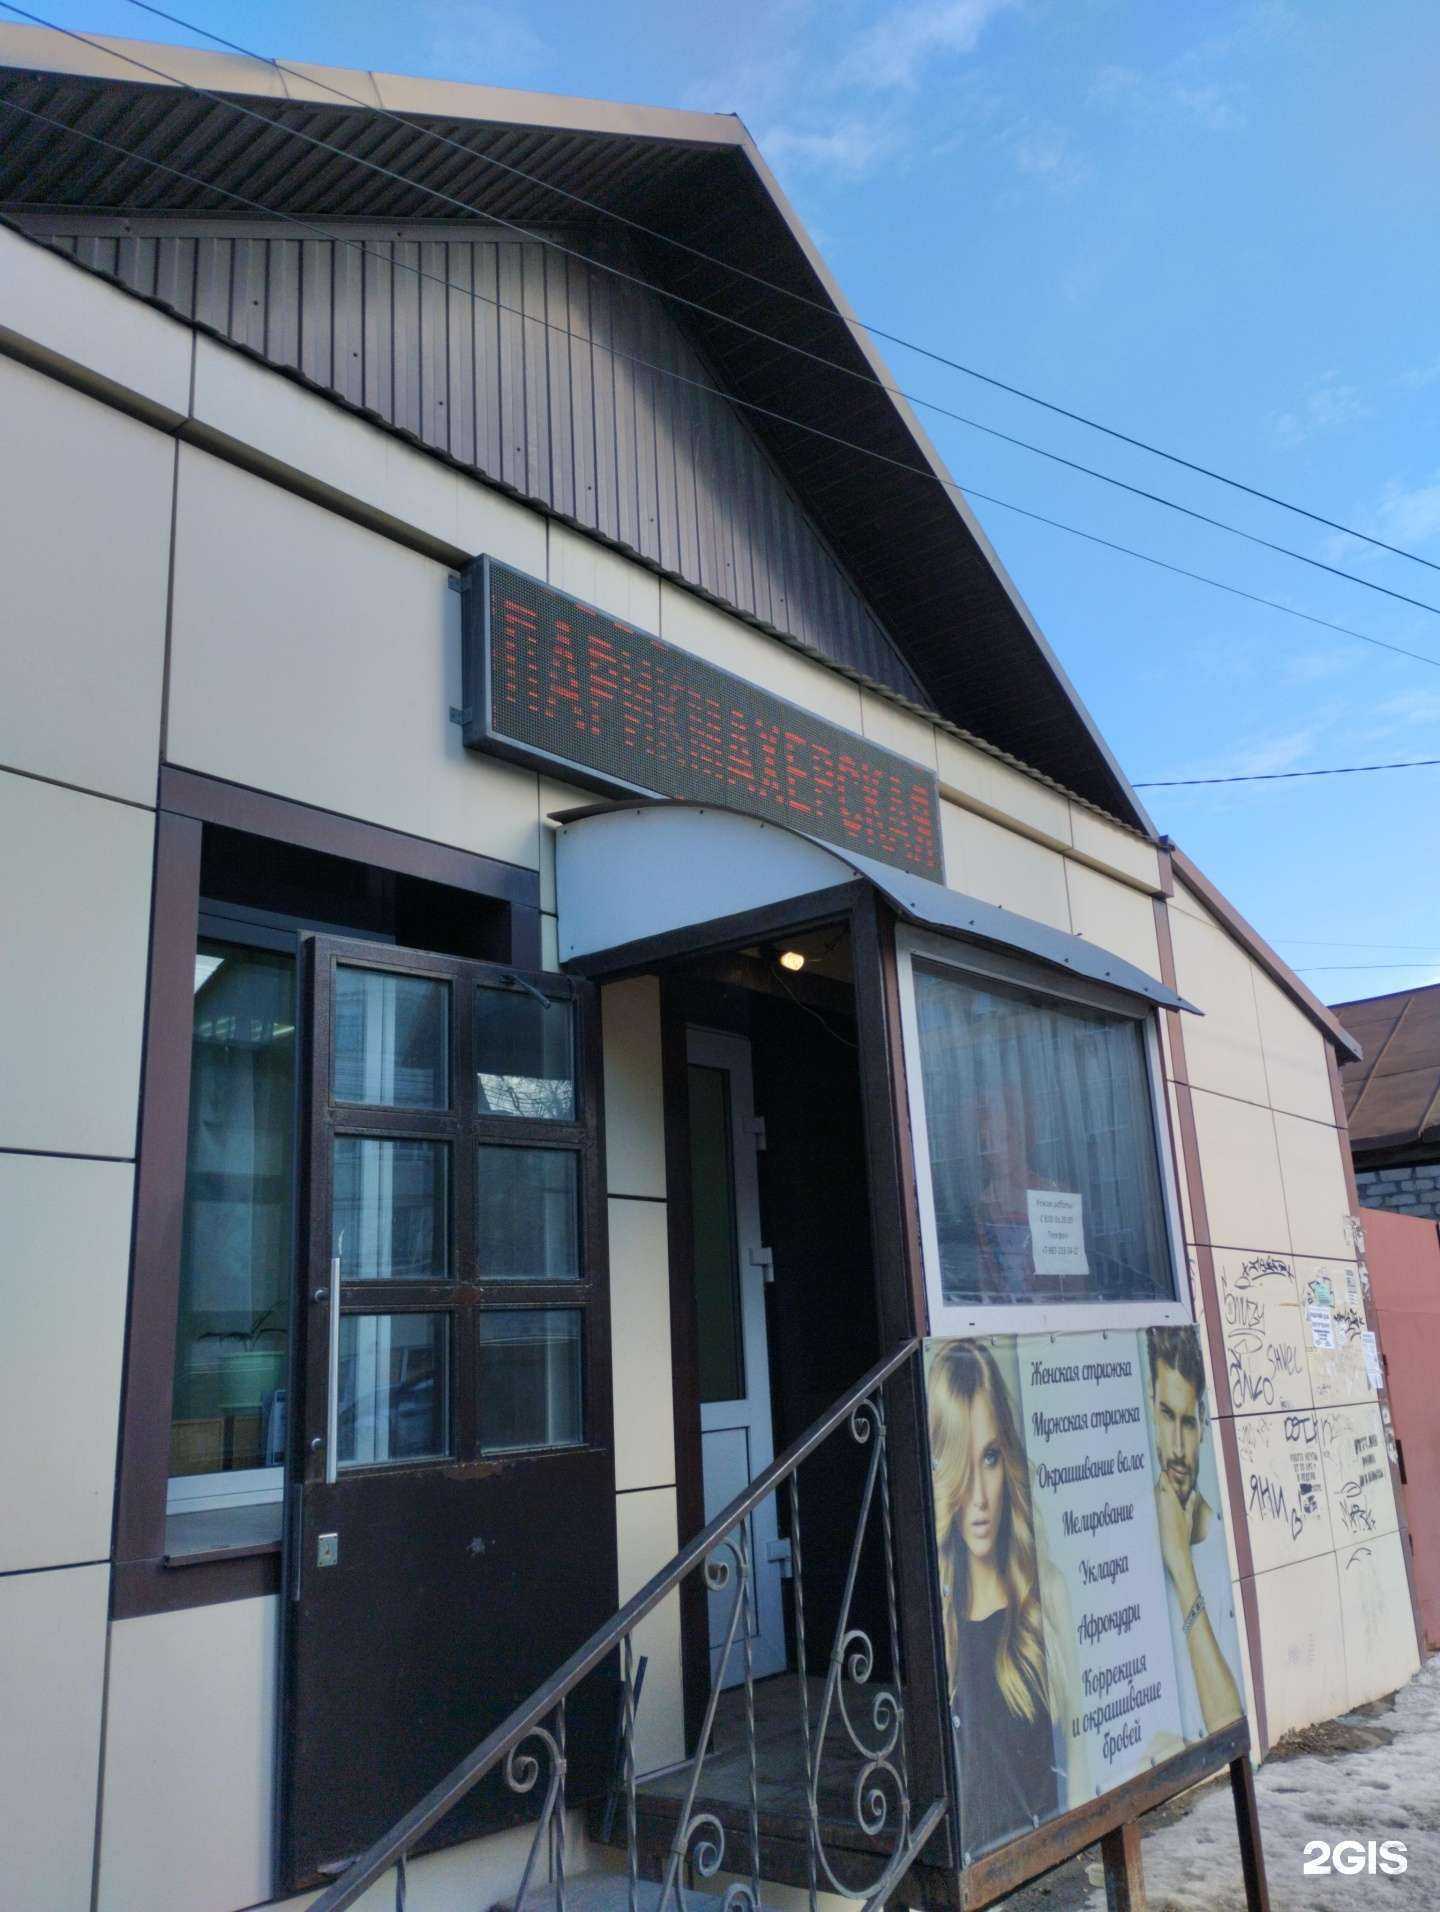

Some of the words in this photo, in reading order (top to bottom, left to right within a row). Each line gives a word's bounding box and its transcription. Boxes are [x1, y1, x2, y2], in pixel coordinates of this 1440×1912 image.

[1031, 1361, 1080, 1386] Женская
[1082, 1361, 1132, 1386] стрижка
[1032, 1412, 1088, 1442] Мужская
[1091, 1407, 1141, 1433] стрижка
[1039, 1456, 1114, 1493] Окрашивание
[1117, 1450, 1145, 1473] волос
[1063, 1502, 1134, 1537] Мелирование
[1079, 1555, 1129, 1585] Укладка
[1078, 1603, 1141, 1645] Афрокудри
[1082, 1653, 1147, 1698] Коррекция
[1072, 1716, 1082, 1738] и
[1083, 1681, 1162, 1735] окрашивание
[1102, 1718, 1142, 1765] бровей
